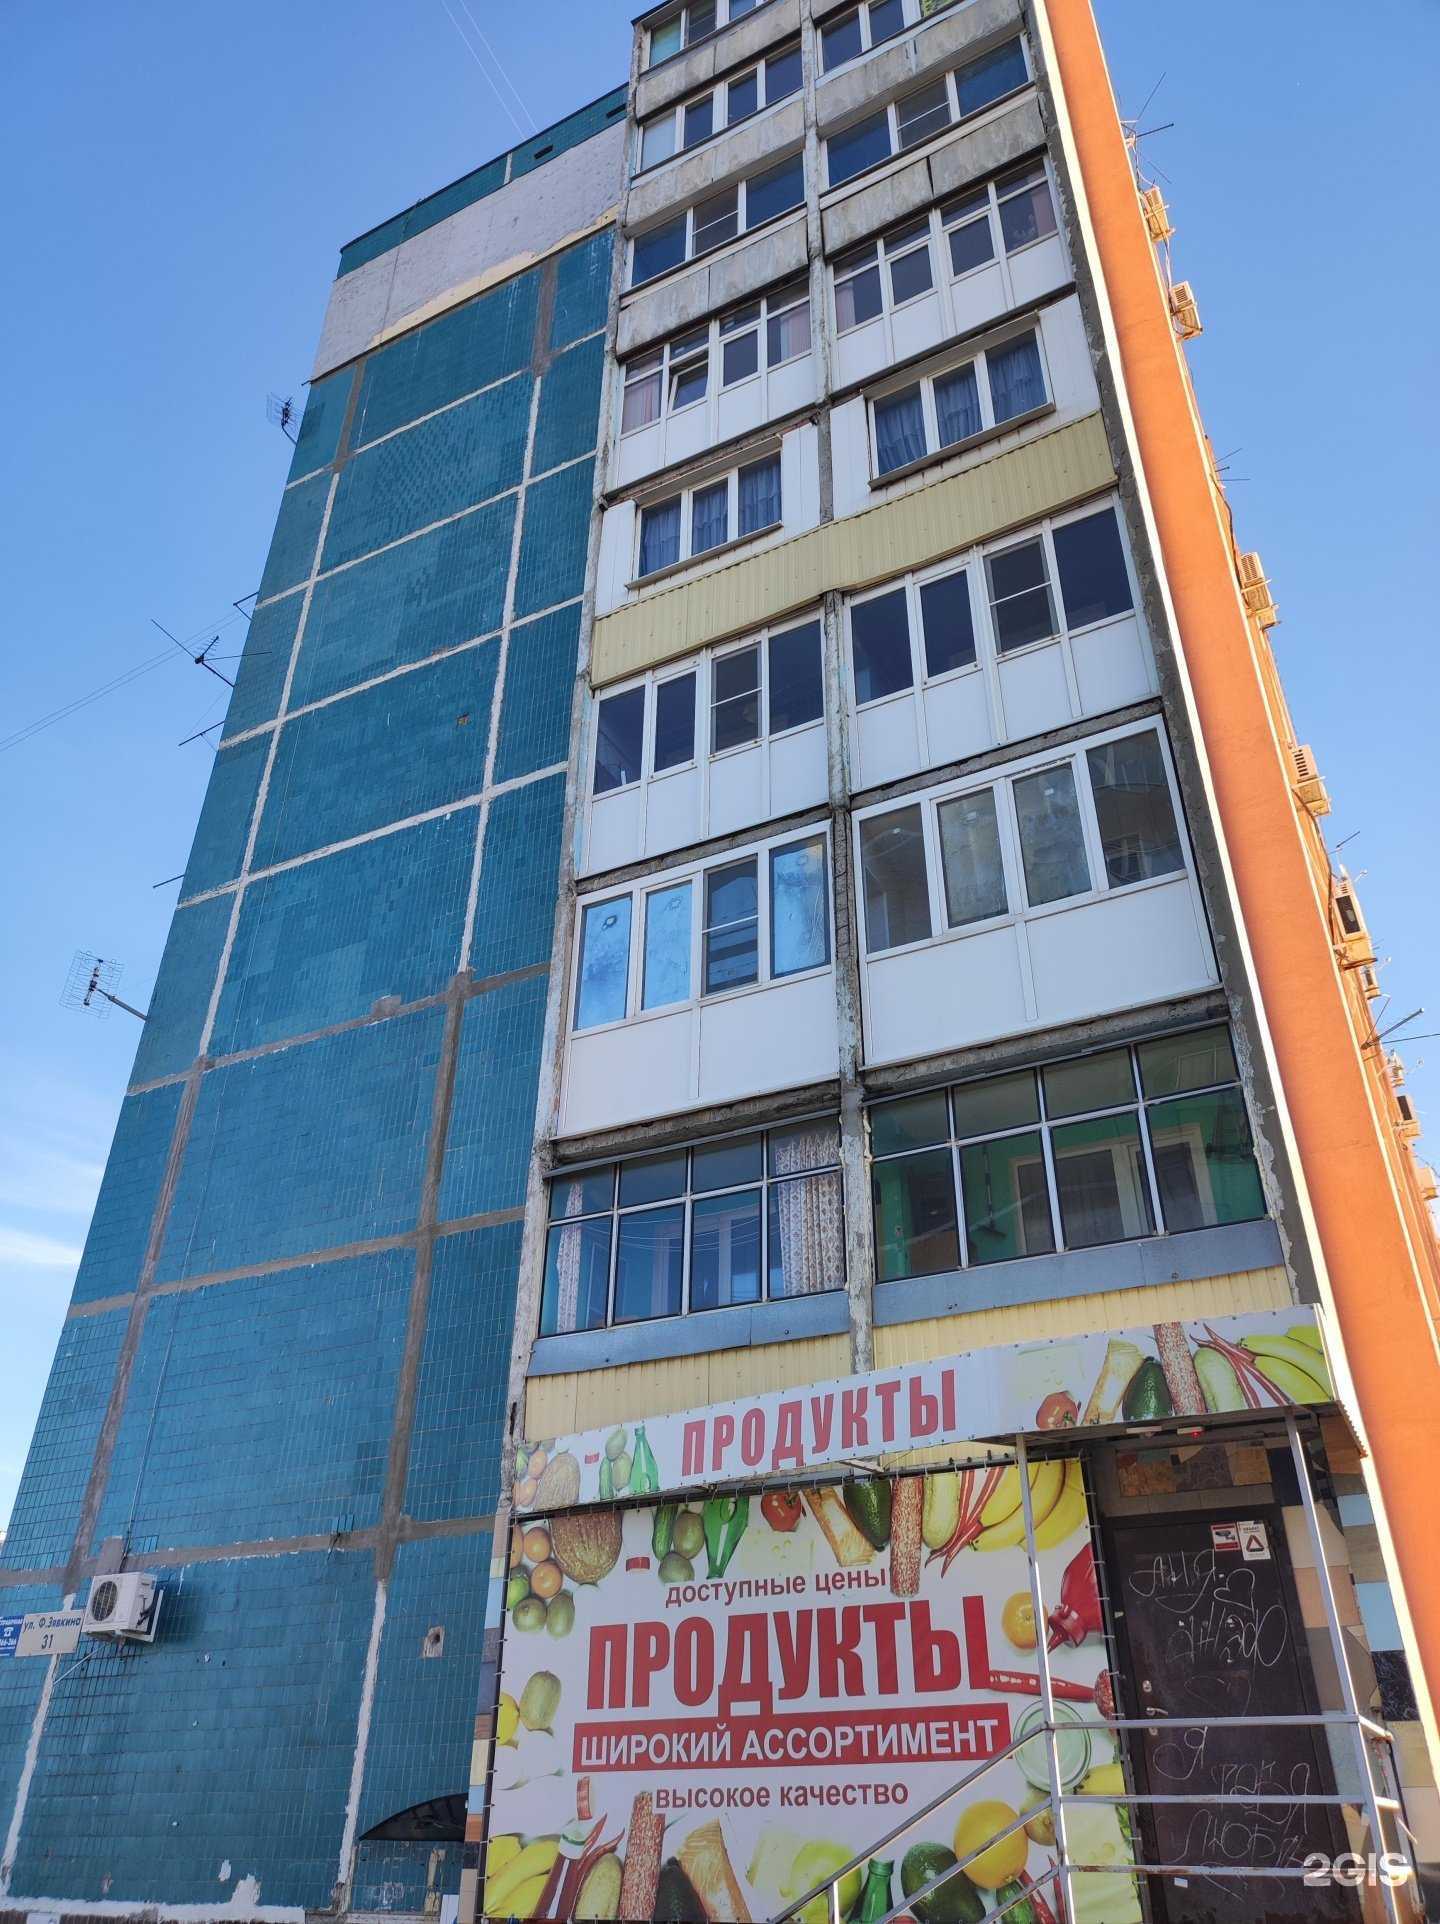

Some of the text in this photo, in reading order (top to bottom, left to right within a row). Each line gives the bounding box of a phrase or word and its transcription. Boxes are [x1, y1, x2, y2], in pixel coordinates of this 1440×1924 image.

[681, 1369, 957, 1477] ПРОДУКТЫ
[665, 1568, 887, 1608] доступные цены
[24, 1620, 35, 1632] ул.
[41, 1634, 54, 1649] 31
[586, 1595, 991, 1716] ПРОДУКТЫ
[581, 1720, 999, 1767] ШИРОКИЙ АССОРТИМЕНТ
[655, 1782, 909, 1809] высокое качество
